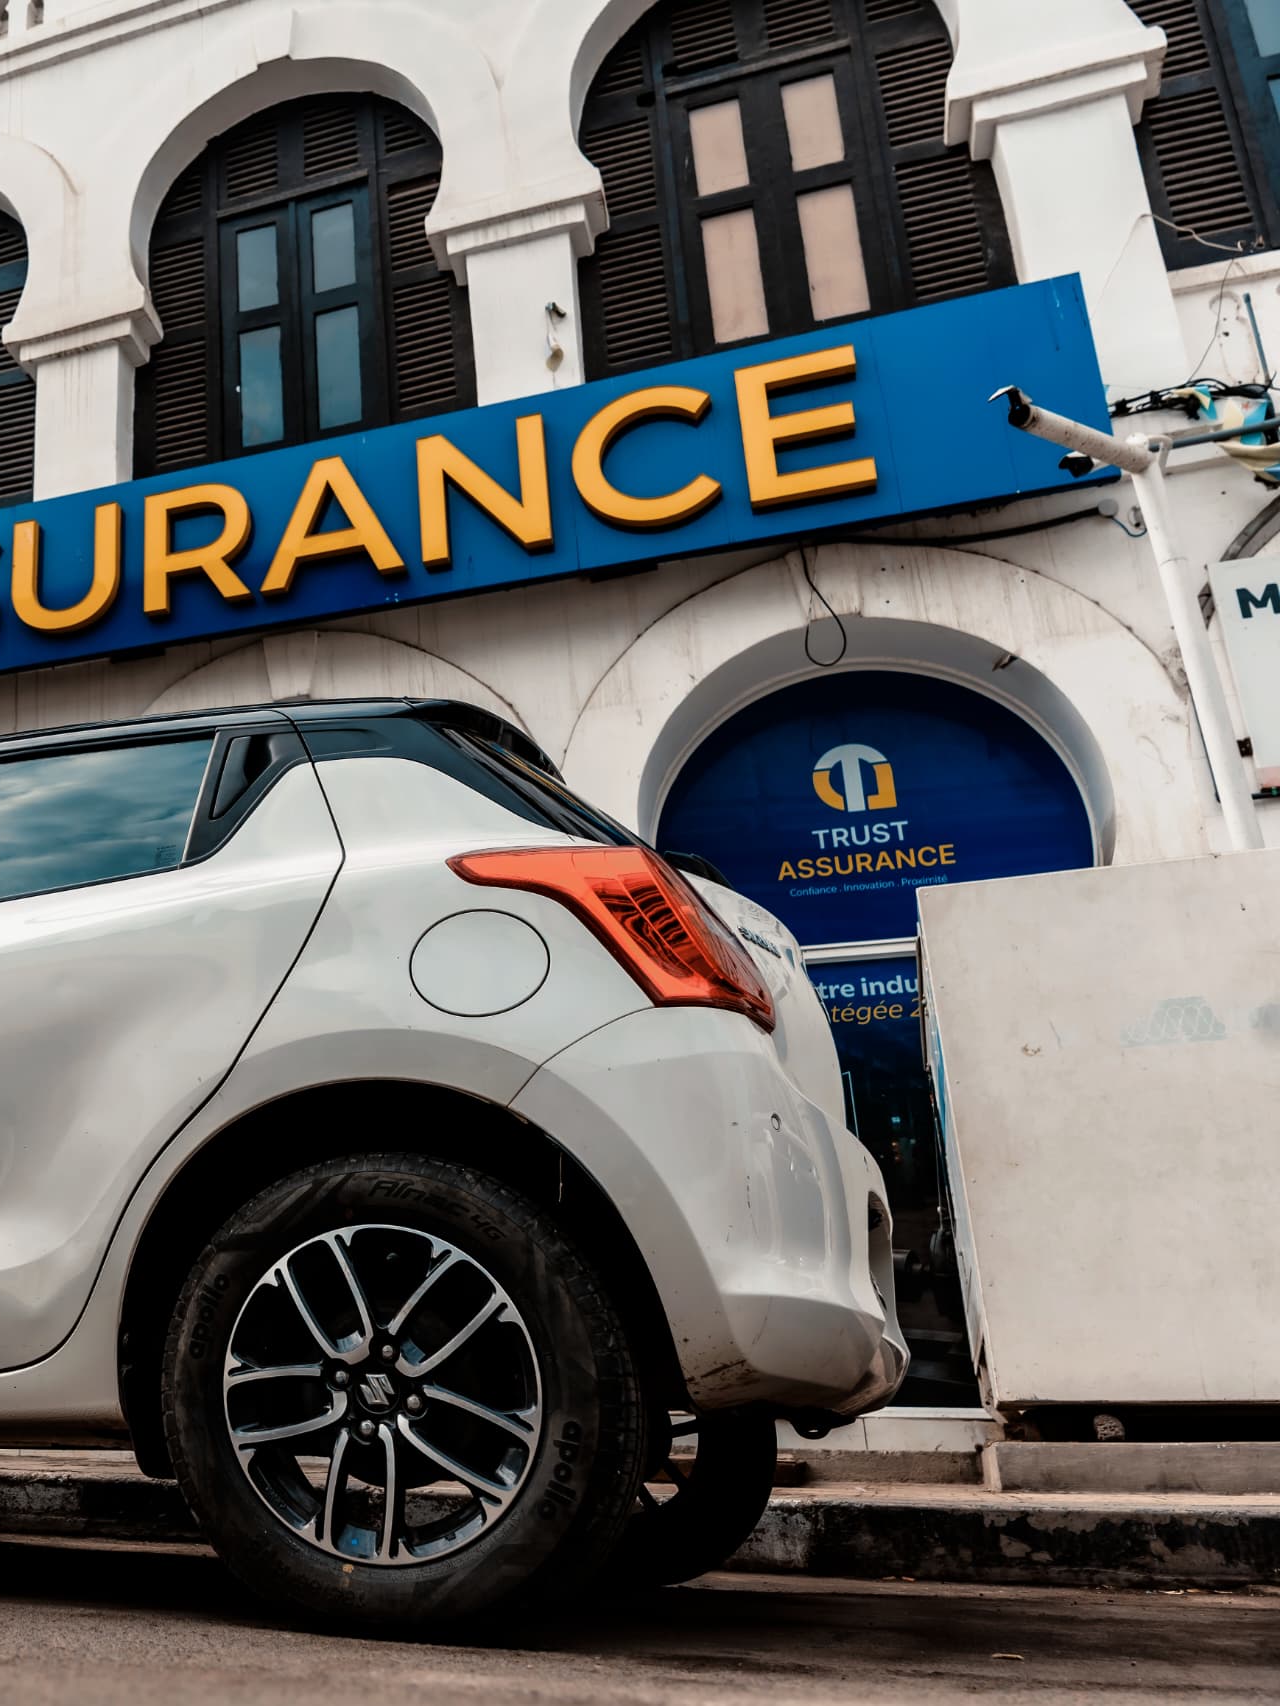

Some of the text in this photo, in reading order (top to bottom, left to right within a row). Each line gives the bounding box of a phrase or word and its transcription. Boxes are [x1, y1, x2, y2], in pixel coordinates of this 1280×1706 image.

[811, 820, 908, 849] TRUST
[778, 843, 956, 880] ASSURANCE
[789, 873, 948, 898] Confiance Innovation Proximité
[538, 1420, 582, 1521] apollo
